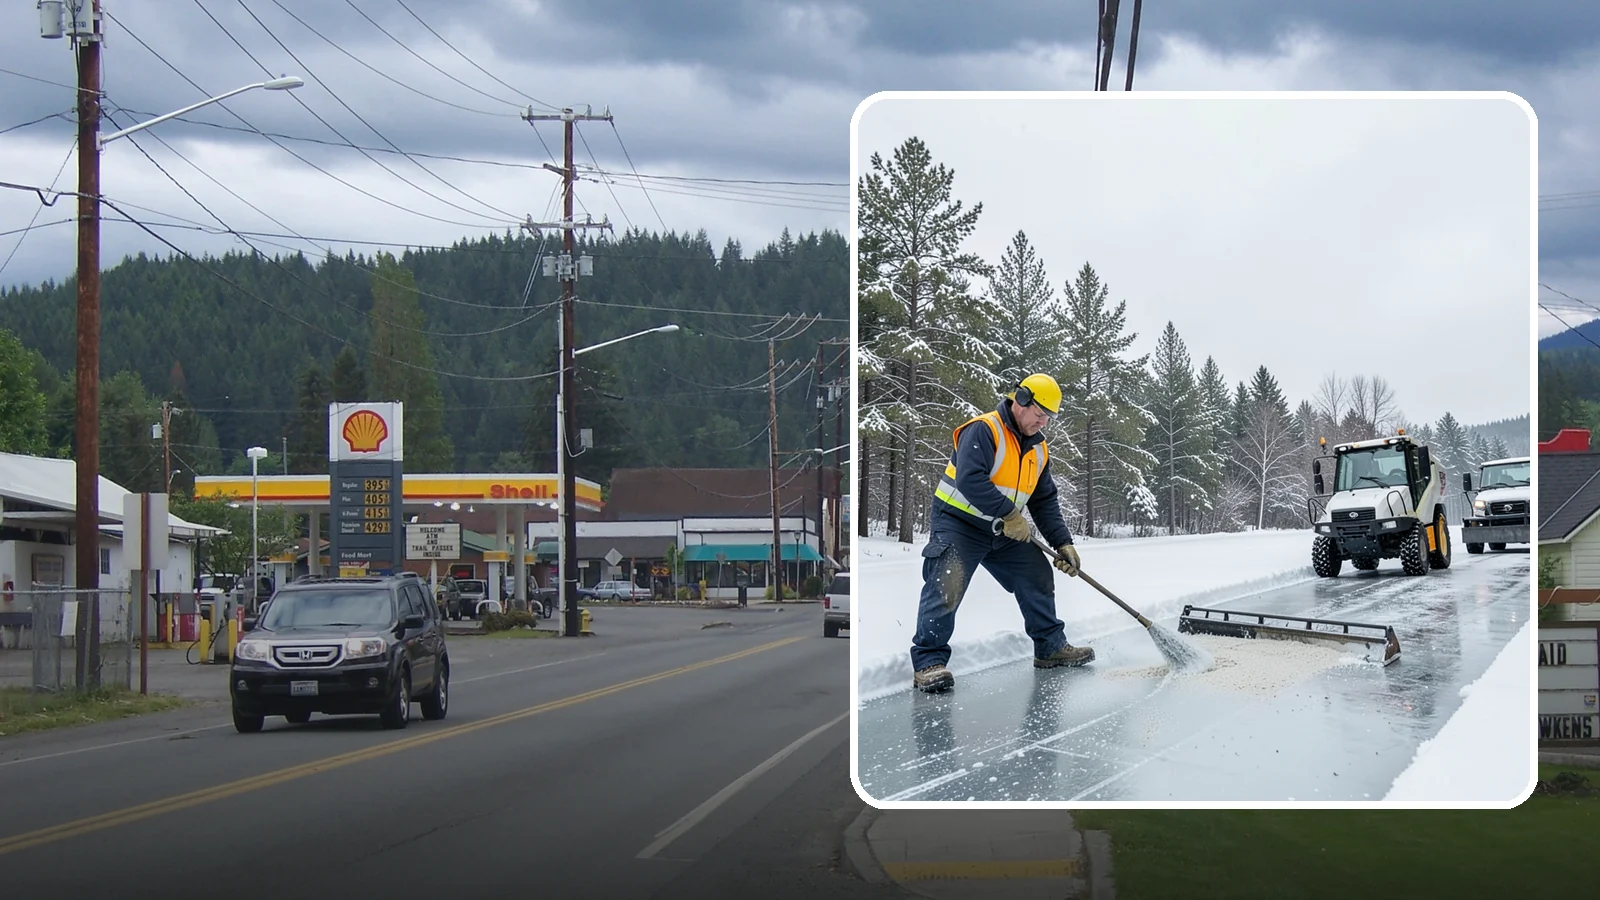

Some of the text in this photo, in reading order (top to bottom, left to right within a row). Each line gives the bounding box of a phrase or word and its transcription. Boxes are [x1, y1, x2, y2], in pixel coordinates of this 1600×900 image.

[365, 480, 384, 490] 395
[490, 484, 547, 498] Shell
[365, 494, 384, 504] 405
[365, 508, 384, 518] 415
[365, 522, 384, 533] 429
